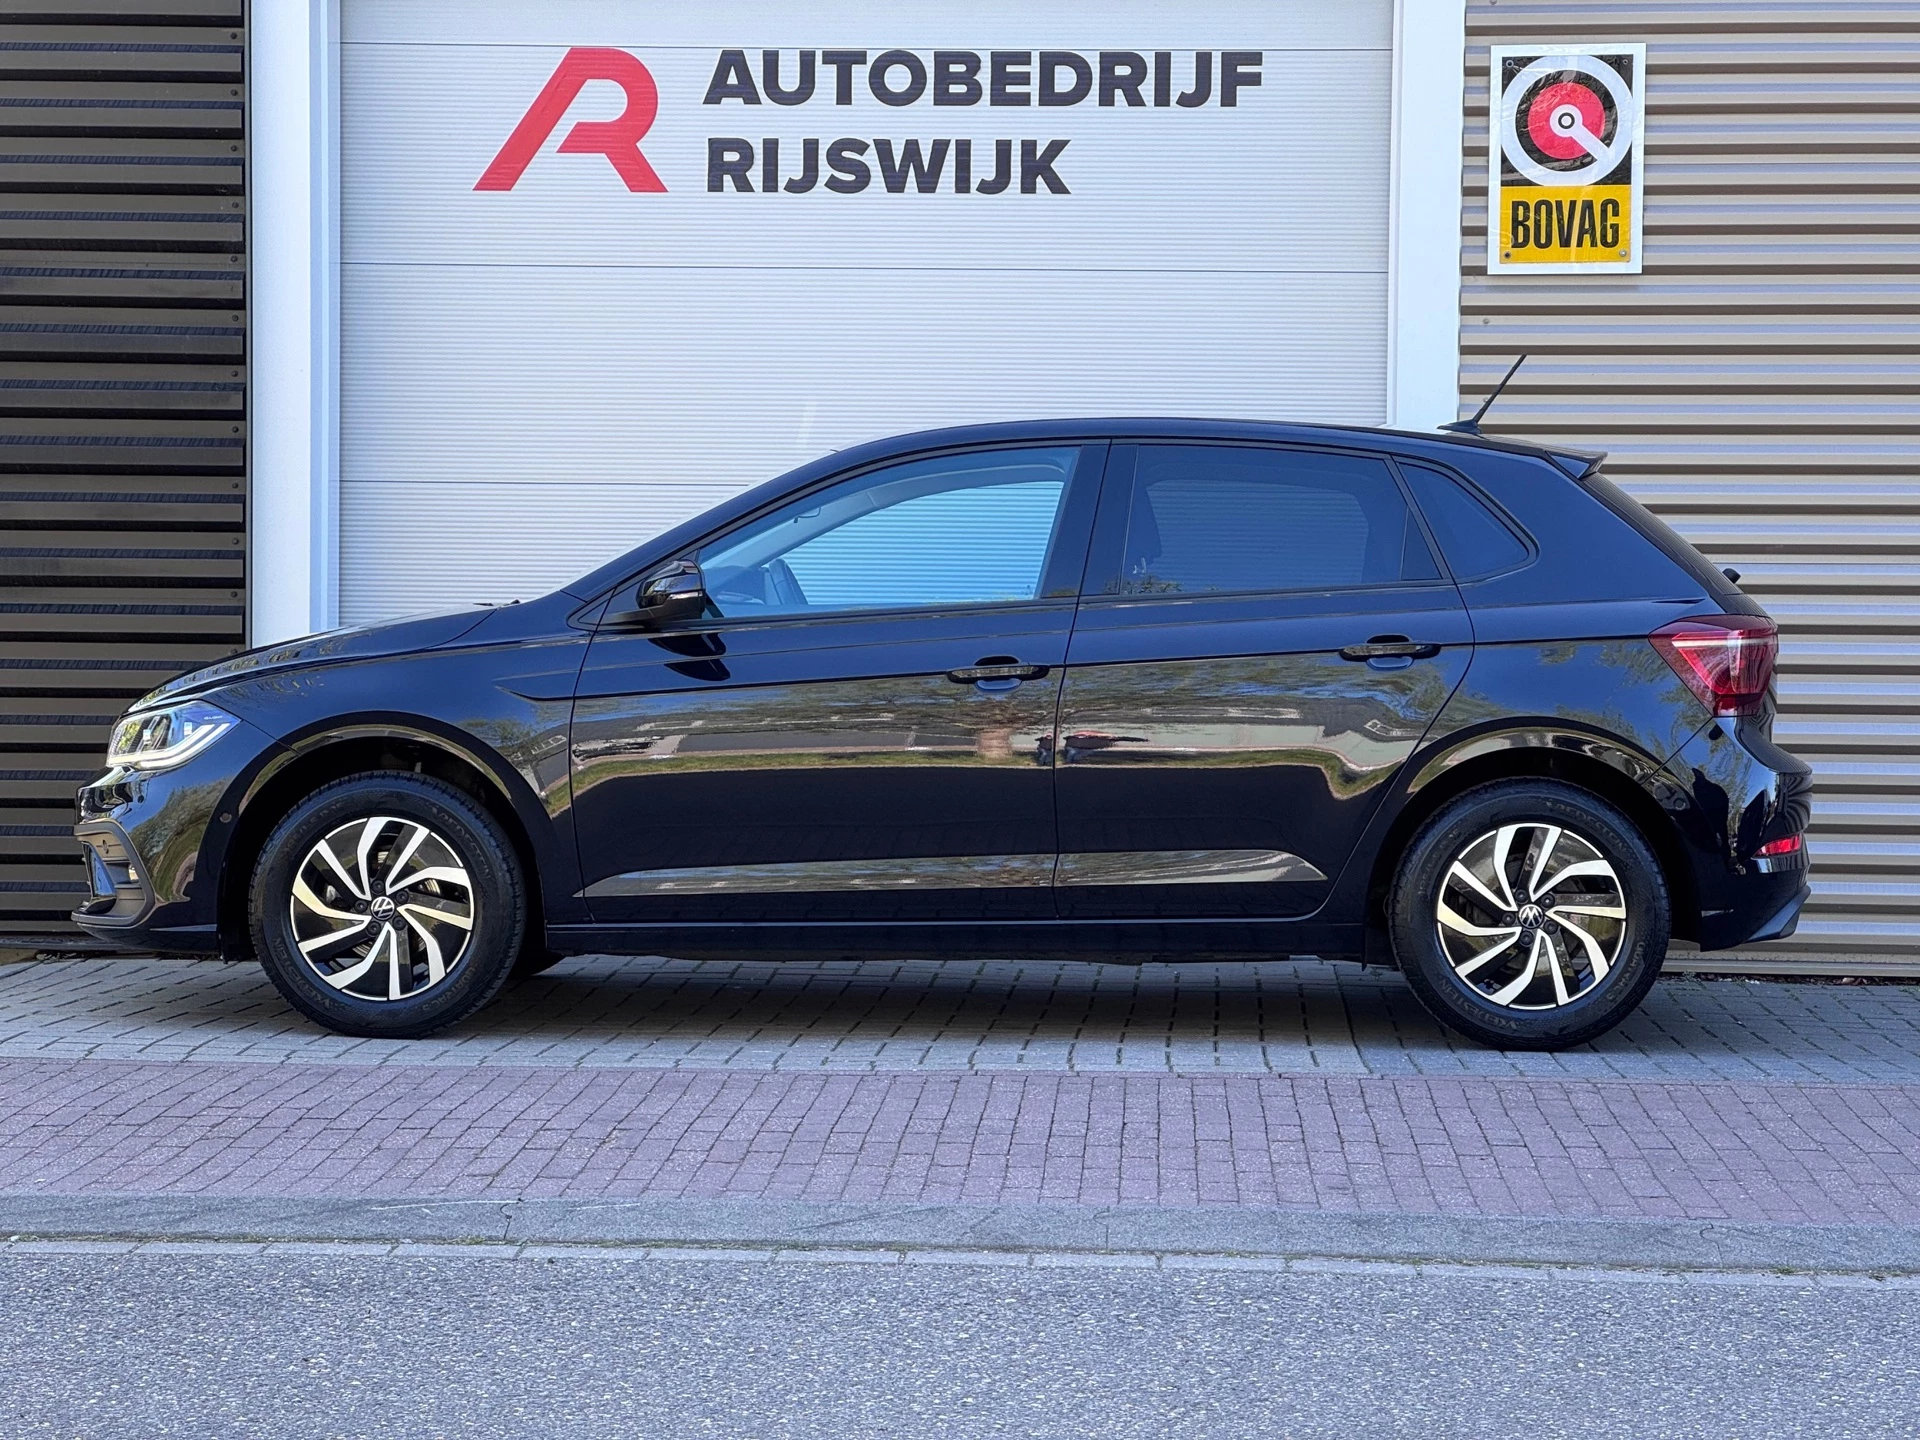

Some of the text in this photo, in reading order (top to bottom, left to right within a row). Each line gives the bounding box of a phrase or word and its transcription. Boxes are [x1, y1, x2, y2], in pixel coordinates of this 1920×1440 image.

[702, 49, 1262, 106] AUTOBEDRIJF
[706, 138, 1071, 194] RIJSWIJK
[1511, 199, 1620, 249] BOVAG
